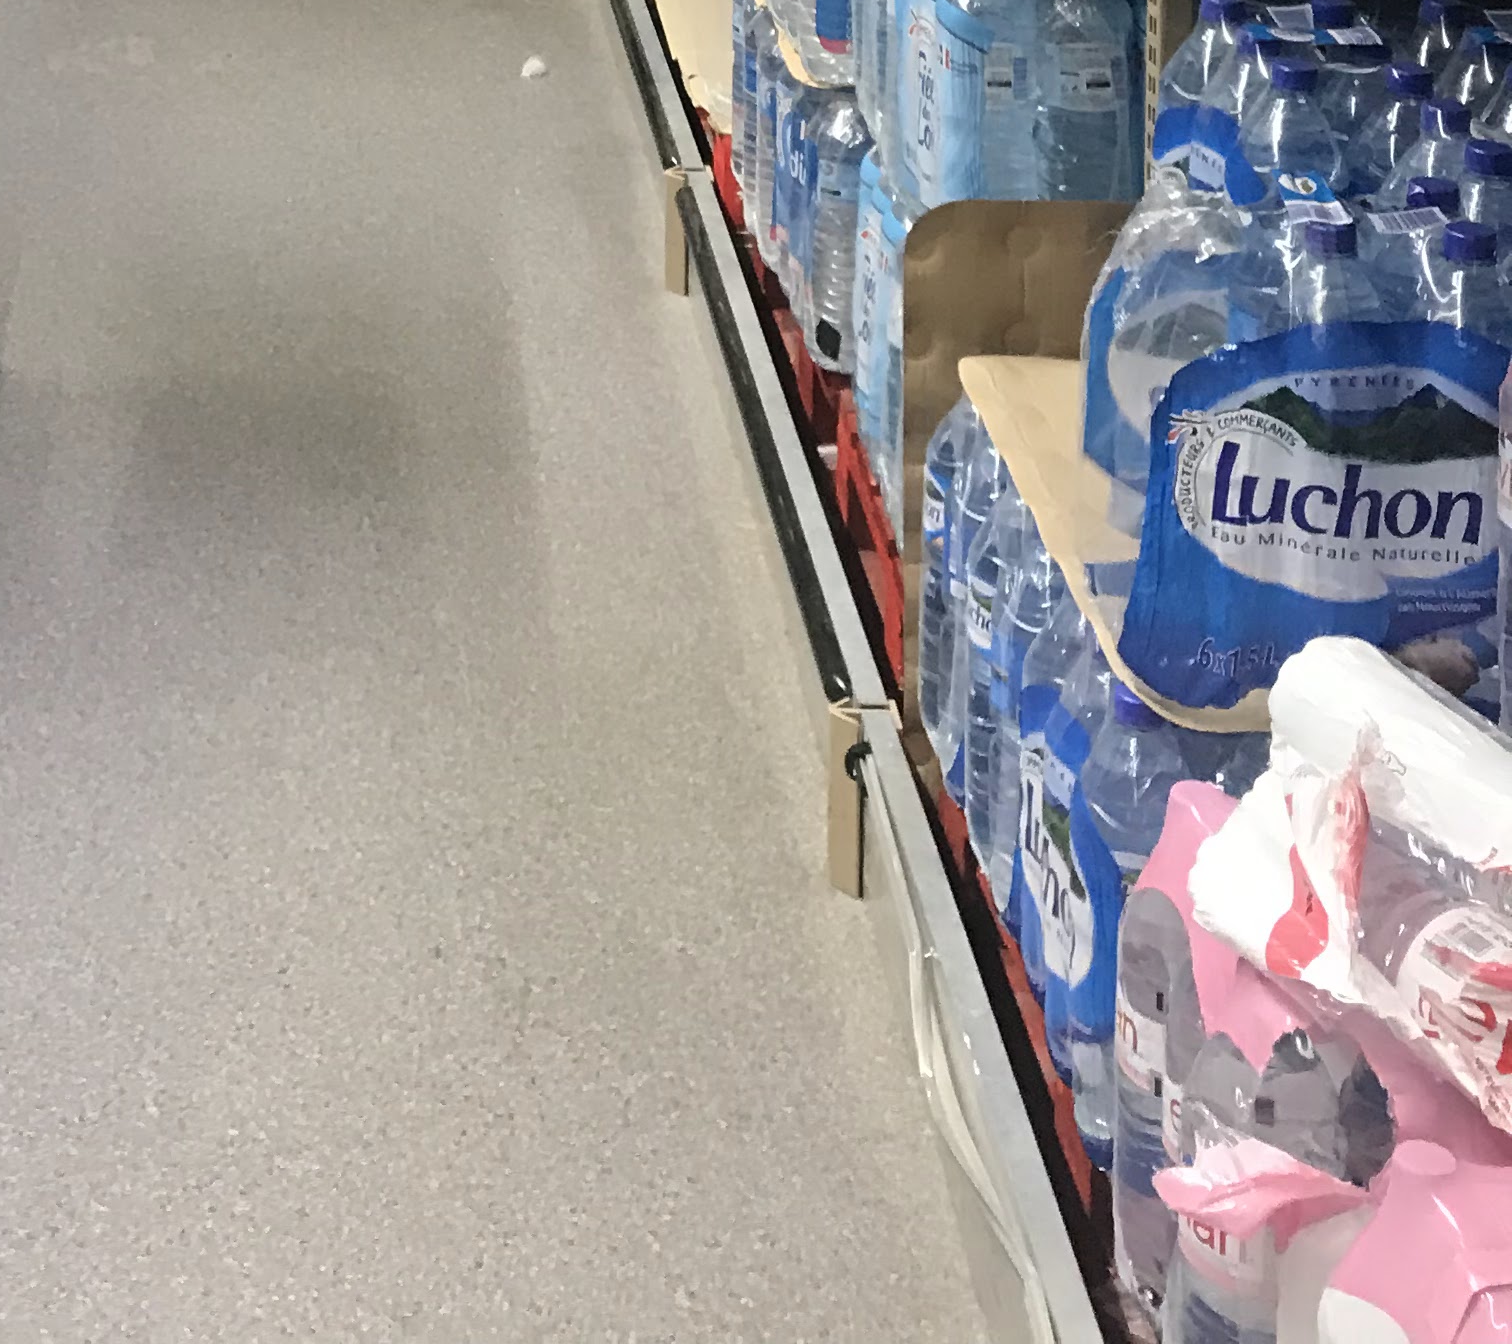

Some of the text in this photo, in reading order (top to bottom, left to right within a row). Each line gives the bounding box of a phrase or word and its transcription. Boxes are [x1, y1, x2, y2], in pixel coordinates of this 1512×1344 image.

[1180, 437, 1205, 531] PRODUCTEURS
[1217, 411, 1298, 448] COMMERÇANTS
[1211, 440, 1484, 546] Luchon
[1211, 526, 1477, 565] Eau Minérale Naturelle
